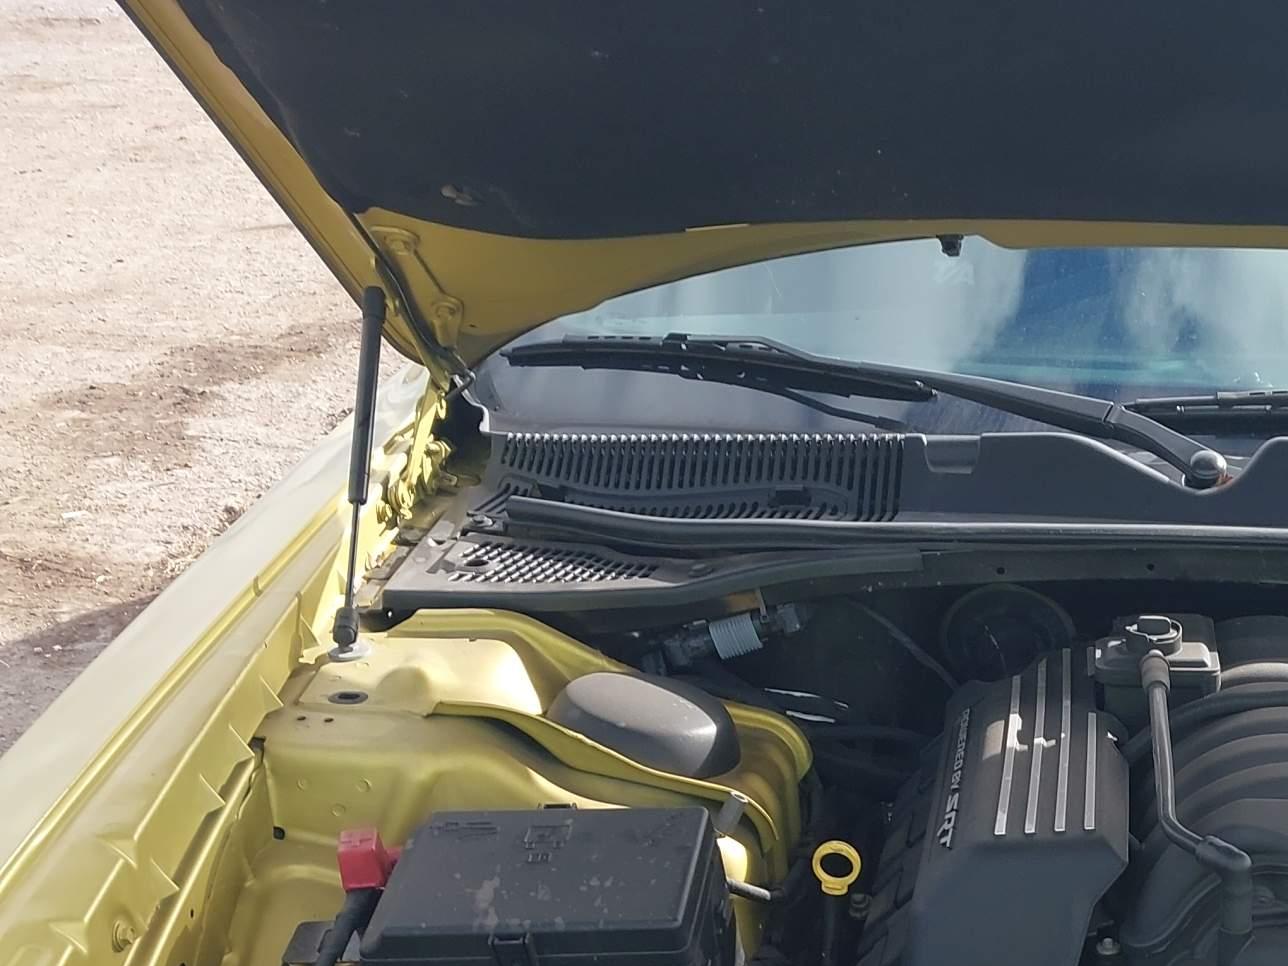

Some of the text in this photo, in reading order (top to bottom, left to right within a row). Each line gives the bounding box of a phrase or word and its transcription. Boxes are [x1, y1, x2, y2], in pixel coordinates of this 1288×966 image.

[937, 708, 970, 848] POWERED BY SRT
